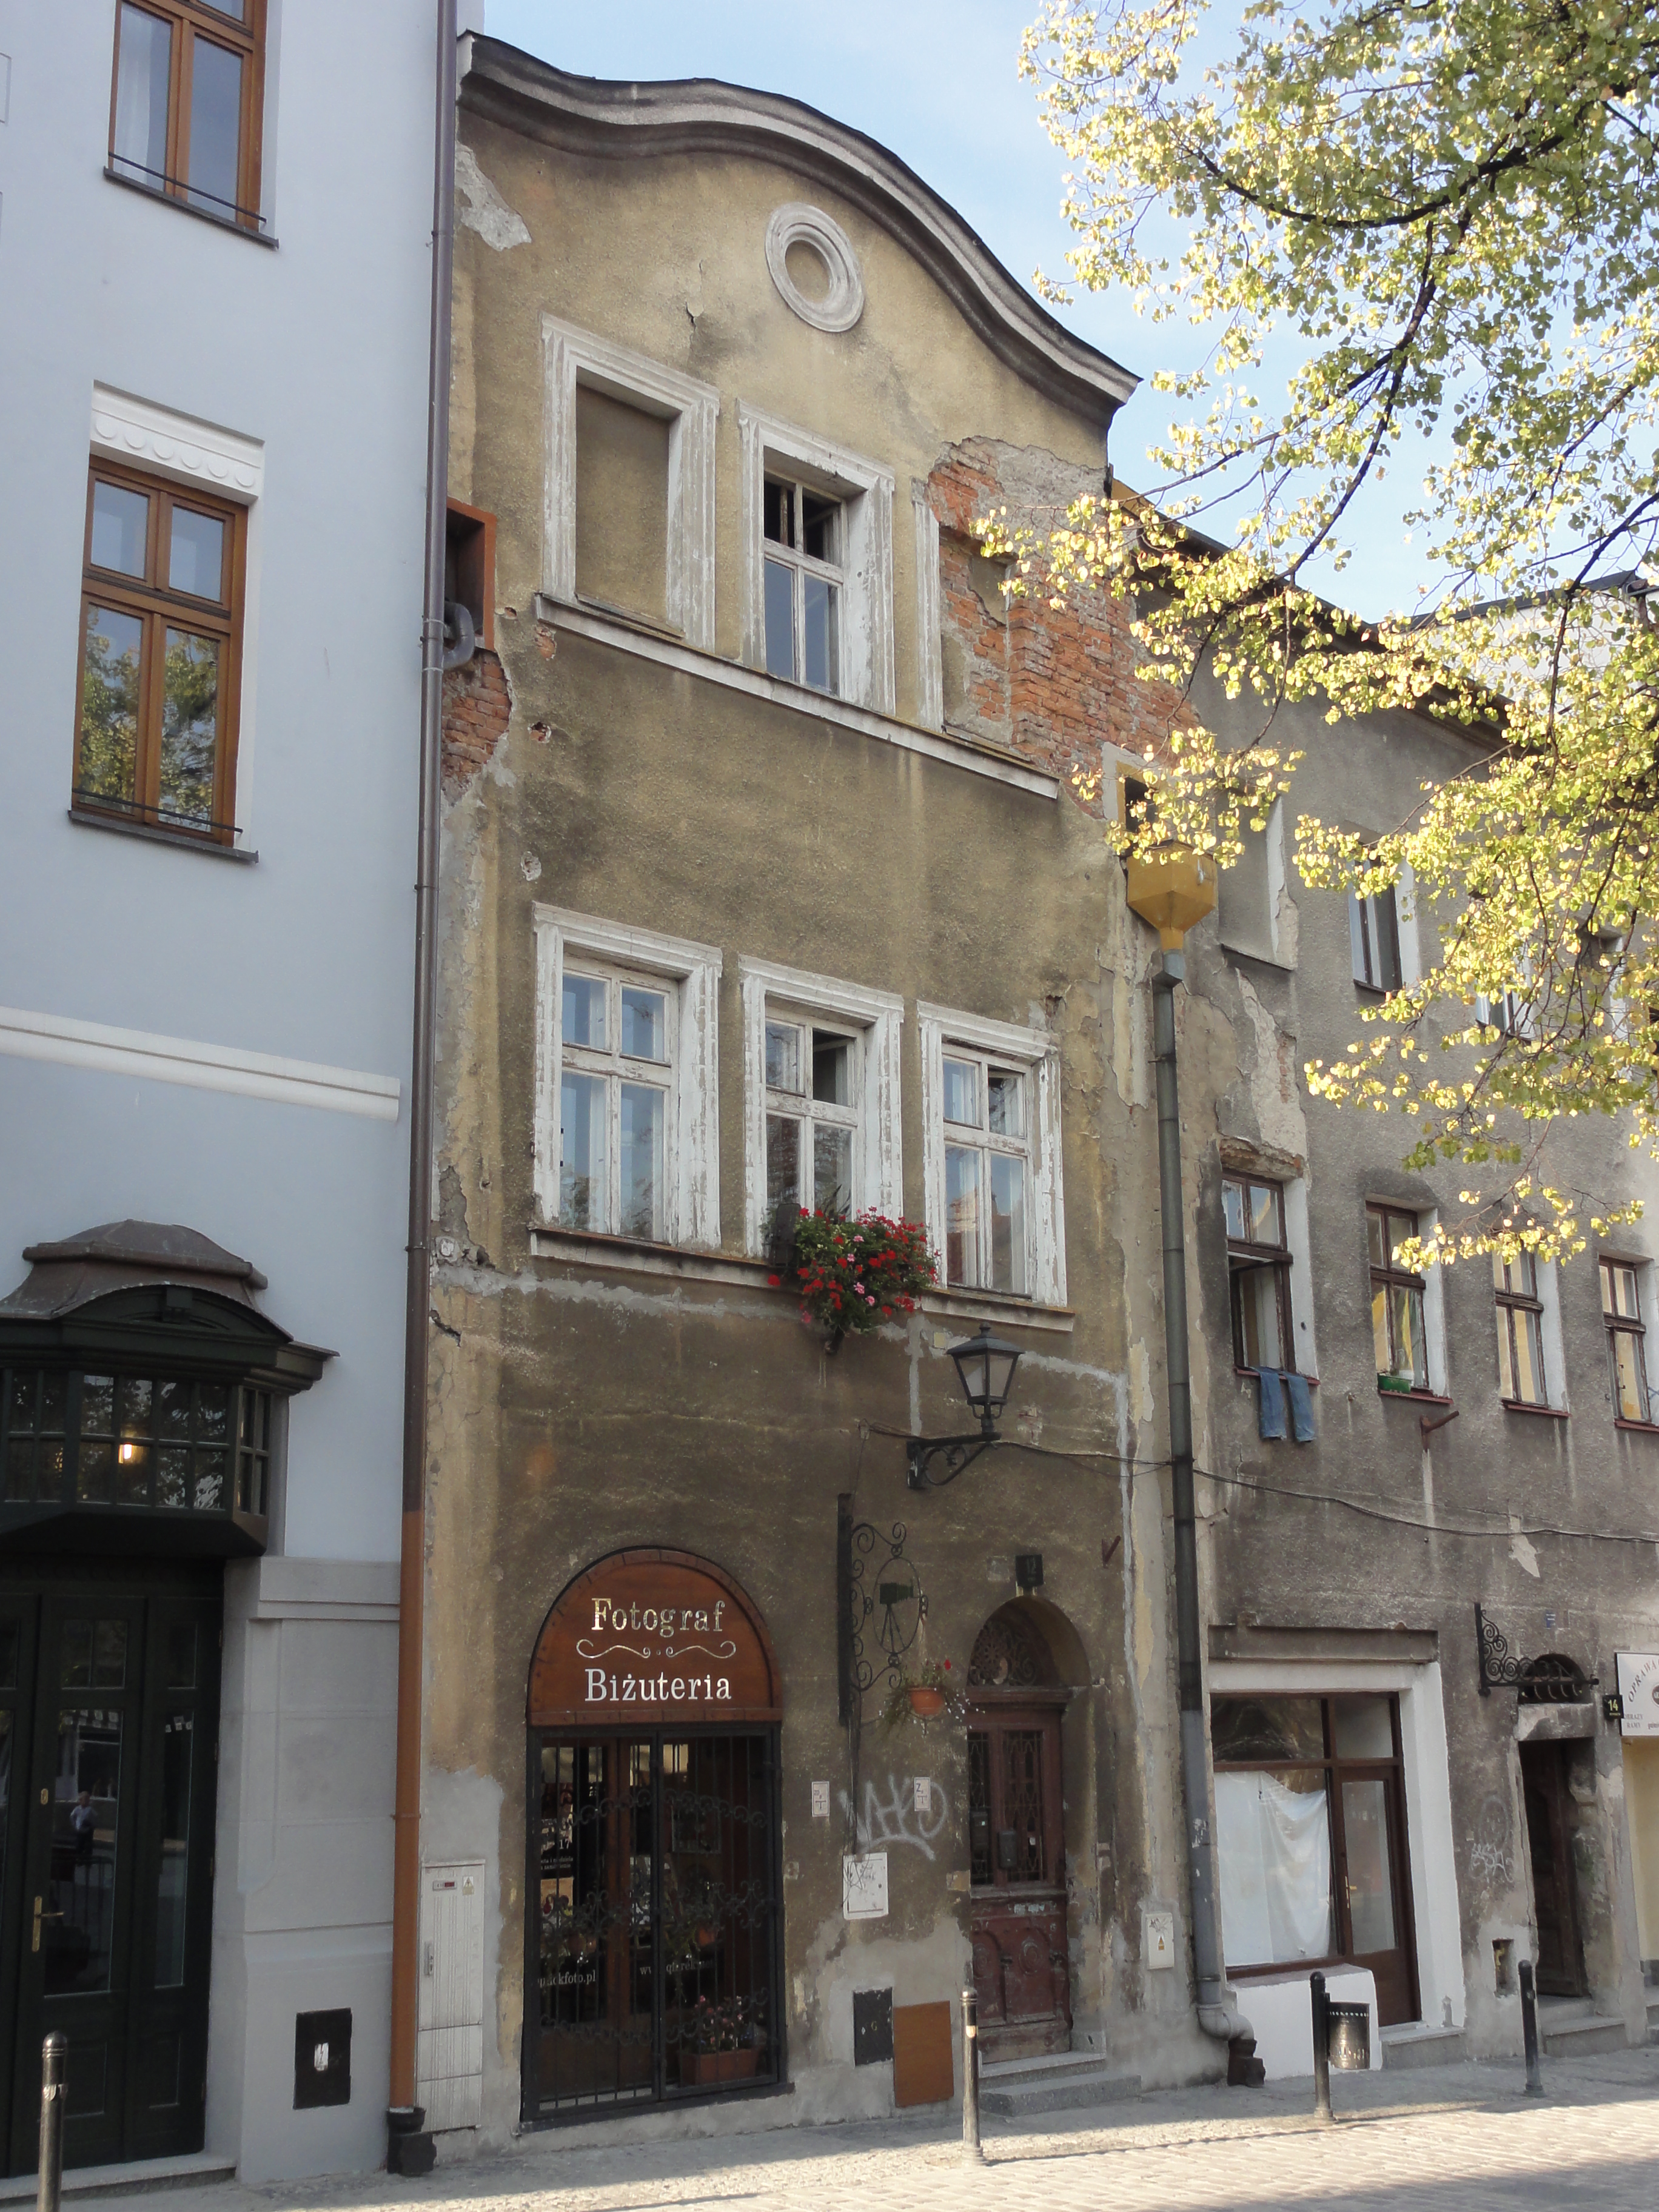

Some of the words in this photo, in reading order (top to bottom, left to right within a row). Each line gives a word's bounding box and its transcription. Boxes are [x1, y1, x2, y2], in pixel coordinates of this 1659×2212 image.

[591, 1597, 725, 1638] Fotograf
[585, 1668, 731, 1701] Biżuteria
[1628, 1659, 1657, 1703] OPRAWA
[1607, 1699, 1618, 1711] 14
